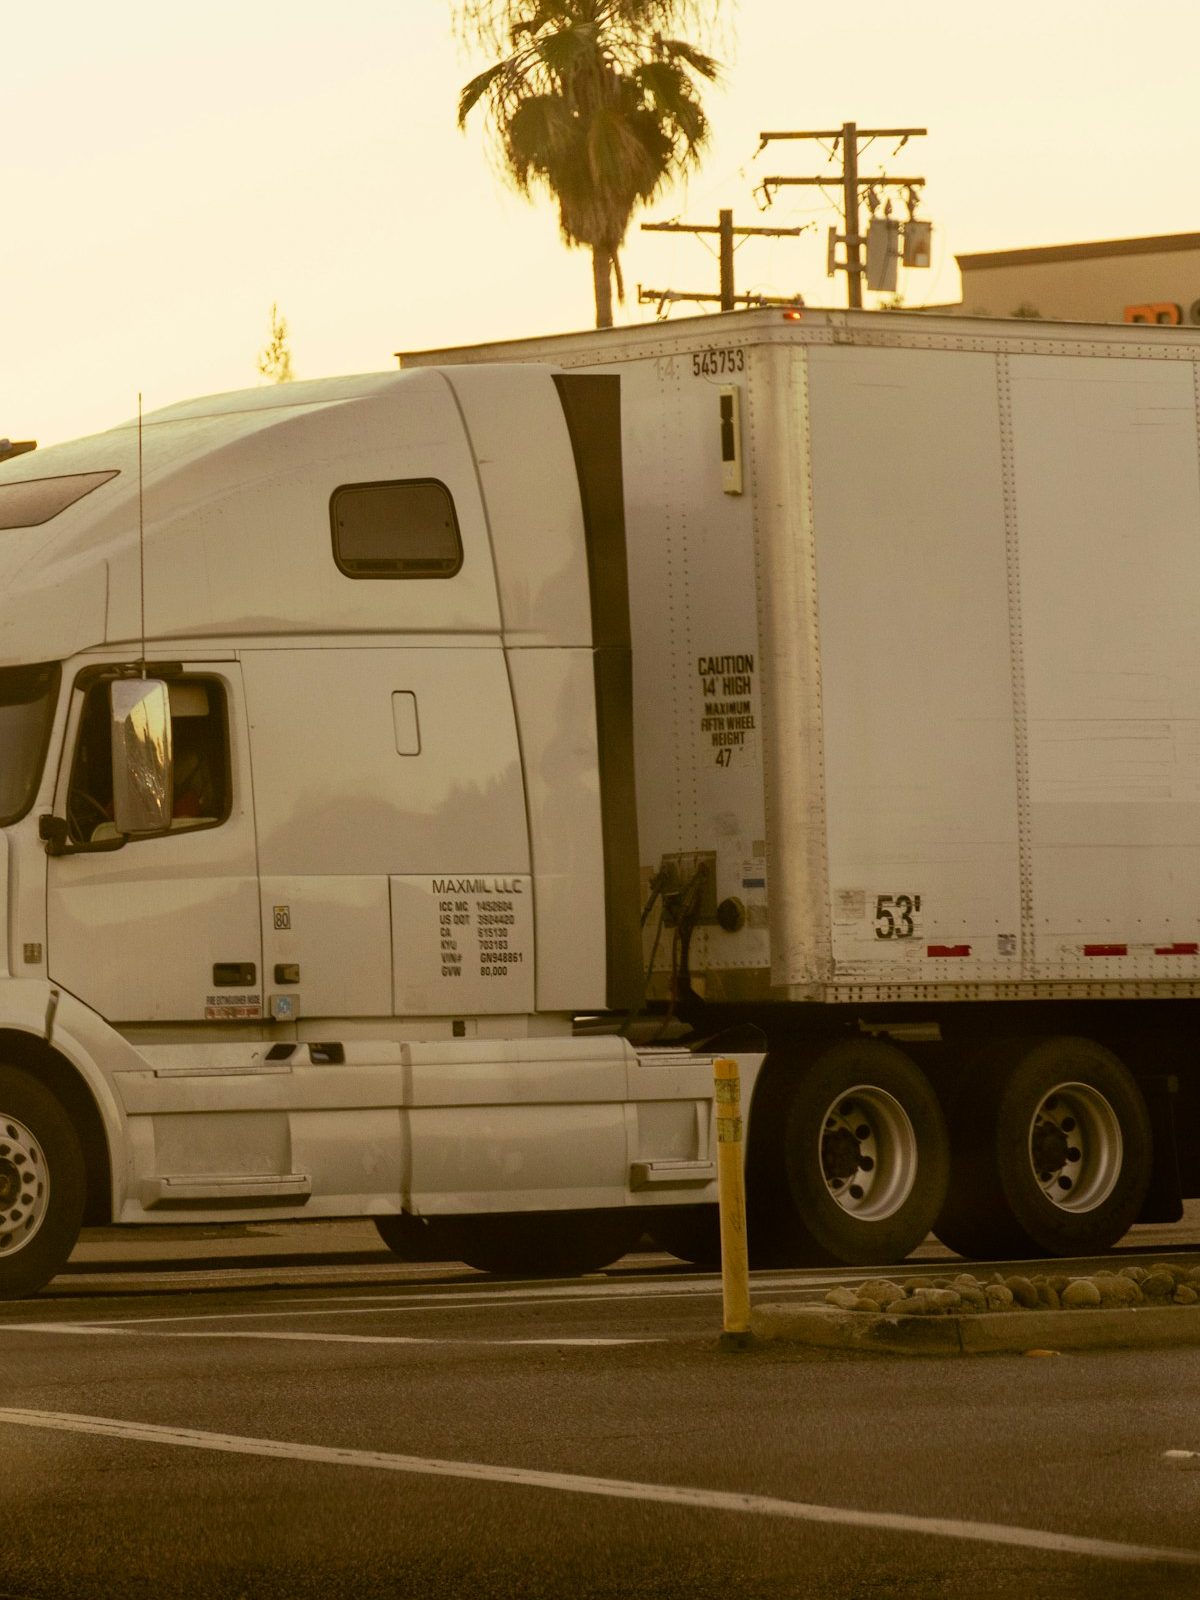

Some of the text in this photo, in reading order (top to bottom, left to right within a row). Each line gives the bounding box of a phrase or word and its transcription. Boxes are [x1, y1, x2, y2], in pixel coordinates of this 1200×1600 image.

[692, 349, 745, 377] 545753
[698, 654, 755, 676] CAUTION
[722, 675, 752, 696] HIGH
[704, 701, 751, 716] MAXIMUM
[701, 715, 756, 732] FIFTH WHEEL
[711, 731, 746, 747] HEIGHT
[432, 879, 523, 894] MAXMIL LLC
[439, 901, 453, 912] ICC
[455, 901, 469, 912] MC
[275, 912, 289, 928] 80
[439, 914, 451, 925] US
[453, 914, 470, 925] DOT
[874, 894, 922, 939] 53'
